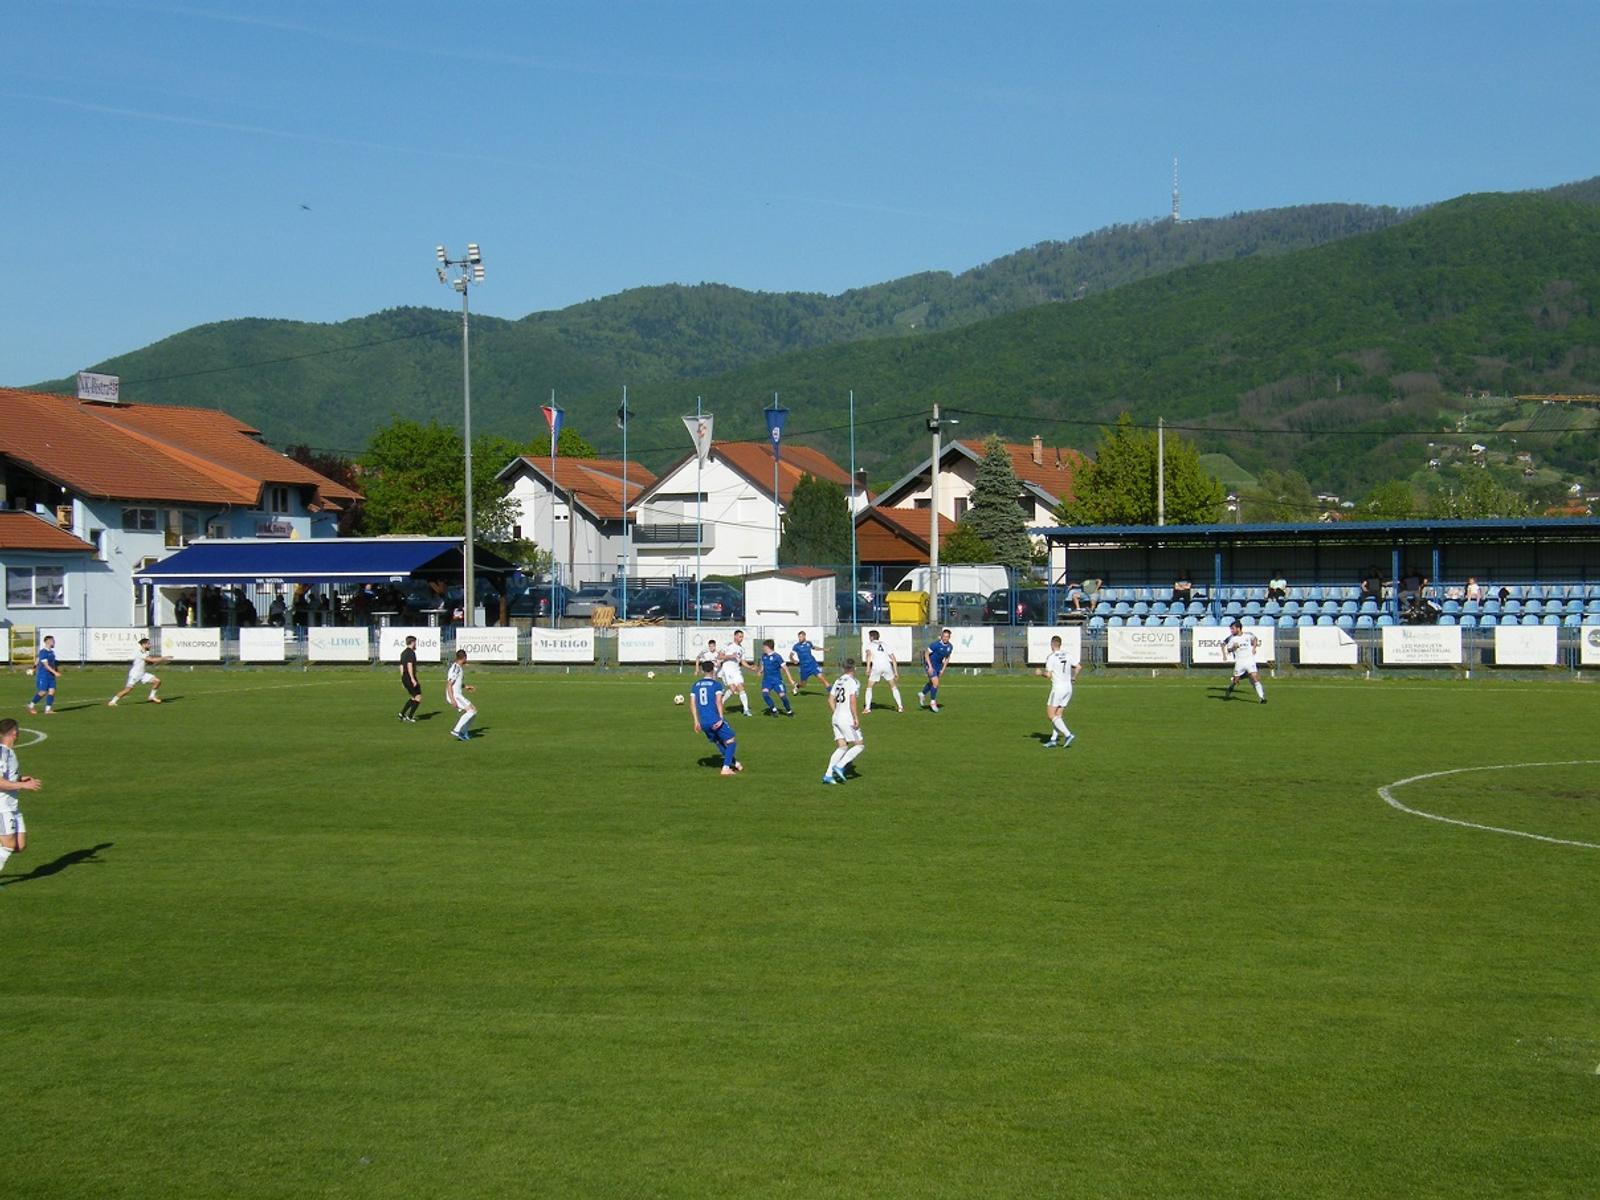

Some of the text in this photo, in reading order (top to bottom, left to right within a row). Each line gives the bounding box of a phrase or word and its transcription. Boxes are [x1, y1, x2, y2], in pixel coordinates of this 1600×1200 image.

[393, 638, 438, 648] Aclade
[1131, 632, 1175, 643] GEOVID
[176, 640, 218, 648] VINKOPROM
[540, 639, 588, 648] M-FRIGO
[1060, 660, 1068, 674] 7
[699, 687, 709, 706] 8
[835, 686, 846, 703] 23
